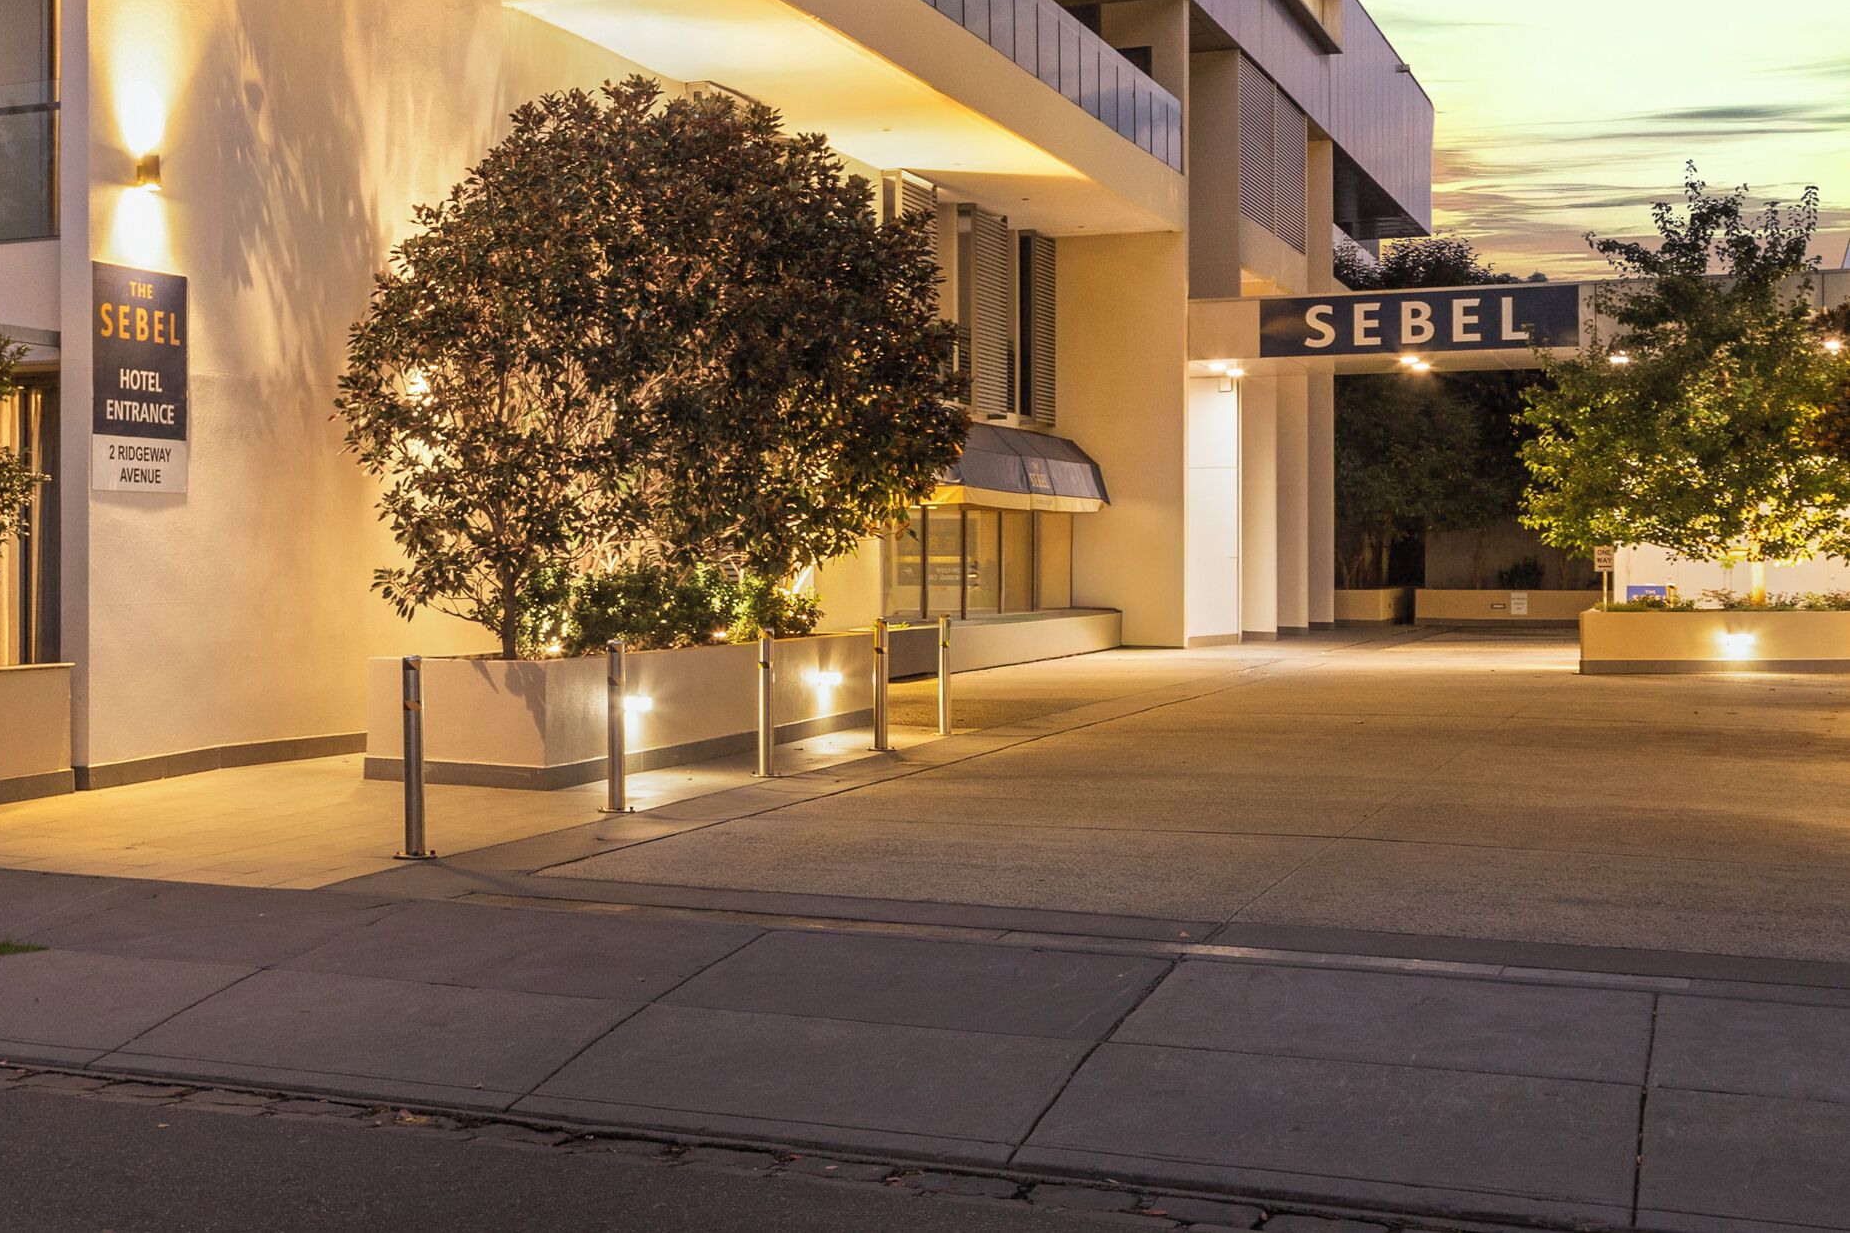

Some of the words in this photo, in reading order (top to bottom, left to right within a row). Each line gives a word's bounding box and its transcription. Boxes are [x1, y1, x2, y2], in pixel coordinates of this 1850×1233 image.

[129, 281, 153, 300] THE
[100, 302, 181, 346] SEBEL
[1303, 296, 1530, 349] SEBEL
[120, 368, 163, 393] HOTEL
[106, 399, 175, 425] ENTRANCE
[109, 445, 116, 460] 2
[118, 445, 172, 463] RIDGEWAY
[120, 468, 161, 484] AVENUE
